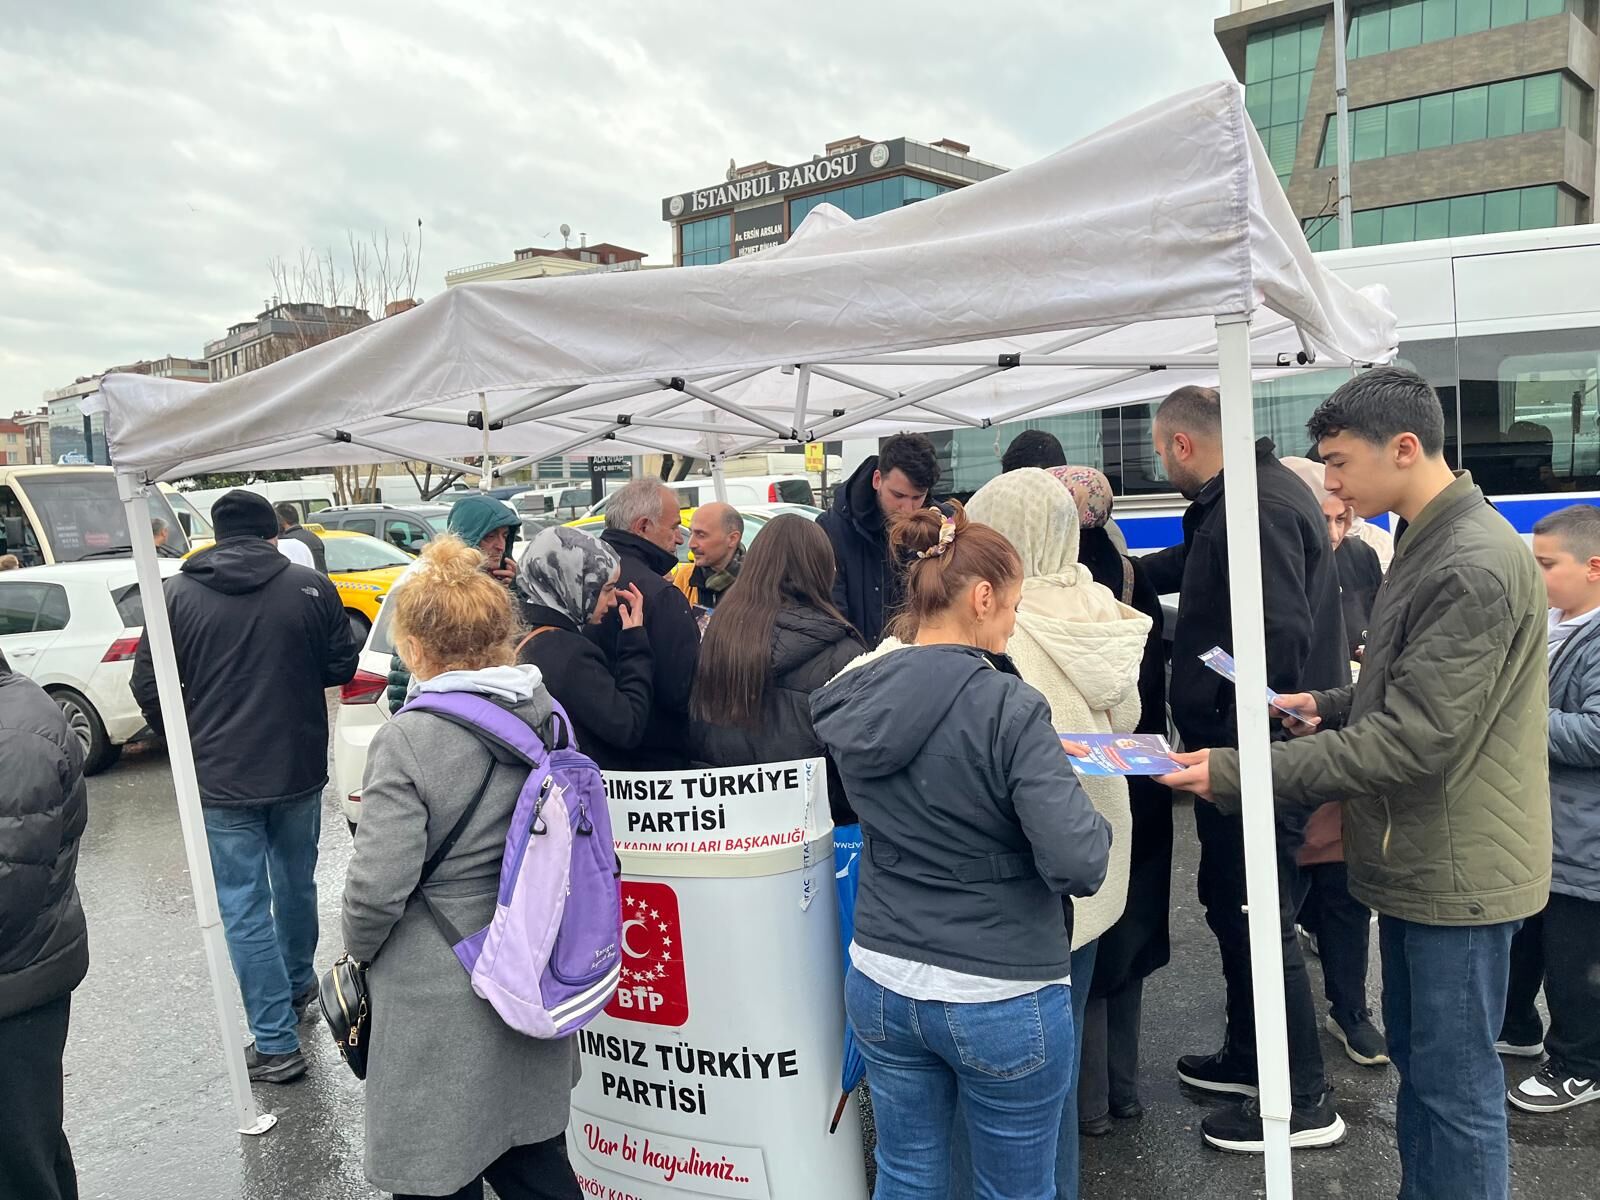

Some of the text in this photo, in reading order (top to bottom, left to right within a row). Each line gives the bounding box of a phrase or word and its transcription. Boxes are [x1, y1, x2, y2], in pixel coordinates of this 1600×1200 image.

[692, 153, 858, 211] İSTANBUL BAROSU
[743, 227, 760, 240] ERSİN
[760, 223, 783, 237] ARSLAN
[681, 767, 799, 799] TÜRKİYE
[628, 803, 725, 833] PARTİSİ
[725, 827, 805, 852] BAŞKANLIĞI
[617, 986, 664, 1012] BTP
[655, 1041, 799, 1079] TÜRKİYE
[601, 1071, 706, 1115] PARTİSİ
[584, 1123, 618, 1156] Var
[622, 1133, 638, 1163] bi
